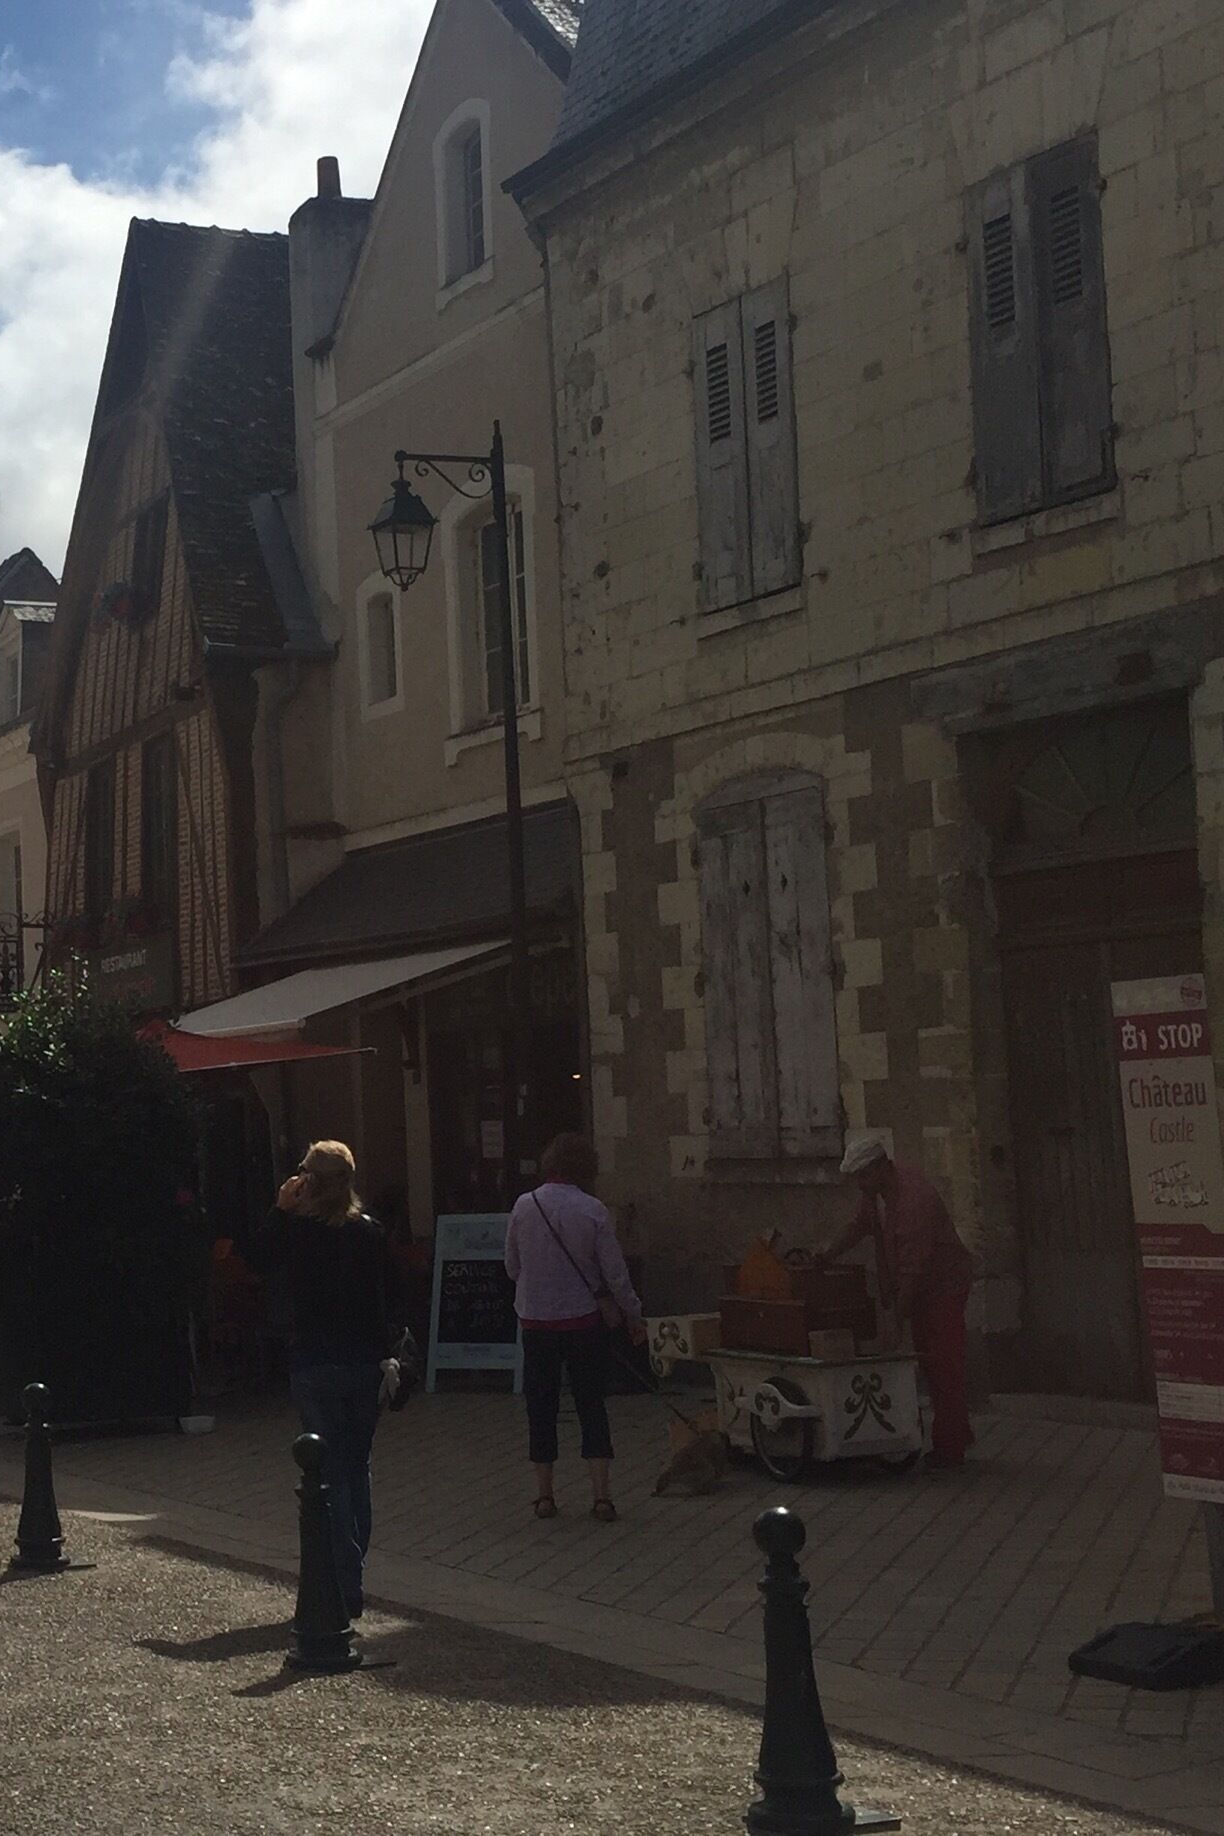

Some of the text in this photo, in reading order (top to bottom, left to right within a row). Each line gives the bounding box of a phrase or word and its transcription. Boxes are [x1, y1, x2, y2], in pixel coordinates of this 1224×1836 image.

[1157, 1022, 1203, 1051] STOP
[1129, 1076, 1207, 1109] Château
[1150, 1116, 1195, 1145] Castle
